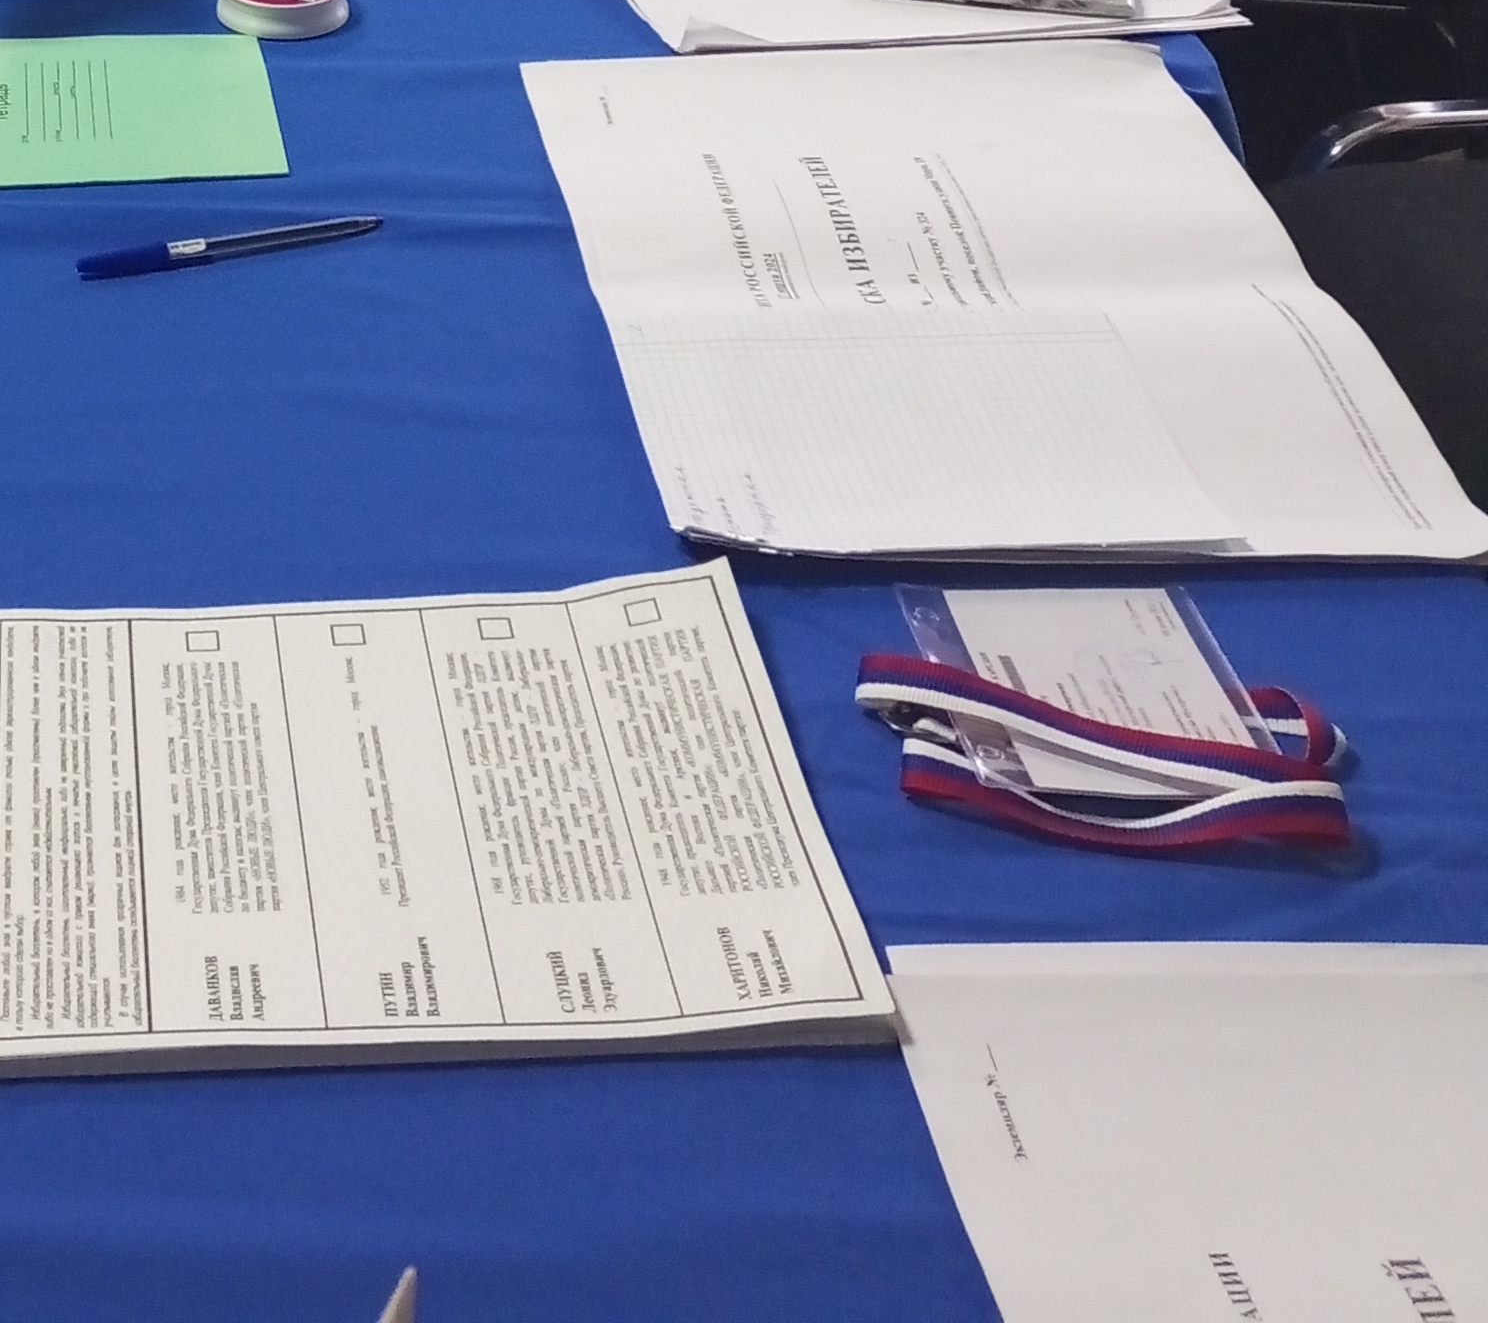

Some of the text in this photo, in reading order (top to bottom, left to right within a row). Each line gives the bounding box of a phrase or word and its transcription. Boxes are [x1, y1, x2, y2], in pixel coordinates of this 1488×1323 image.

[798, 156, 870, 272] ИЗБИРАТЕЛЕЙ
[916, 211, 930, 225] 324
[724, 207, 759, 291] РОССИЙСКОЙ
[203, 954, 223, 1022] ДАВАНКОВ
[227, 963, 243, 1023] Владислав
[248, 962, 265, 1020] Андреевич
[378, 970, 399, 1019] ПУТИН
[399, 959, 420, 1019] Владимир
[416, 934, 441, 1019] Владимирович
[547, 949, 575, 1013] СЛУЦКИЙ
[575, 970, 597, 1012] Леонид
[591, 945, 617, 1011] Эдуардович
[715, 925, 753, 1002] ХАРИТОНОВ
[744, 949, 775, 1000] Николай
[760, 928, 795, 996] Михайлович
[994, 1091, 1028, 1161] Экземпляр
